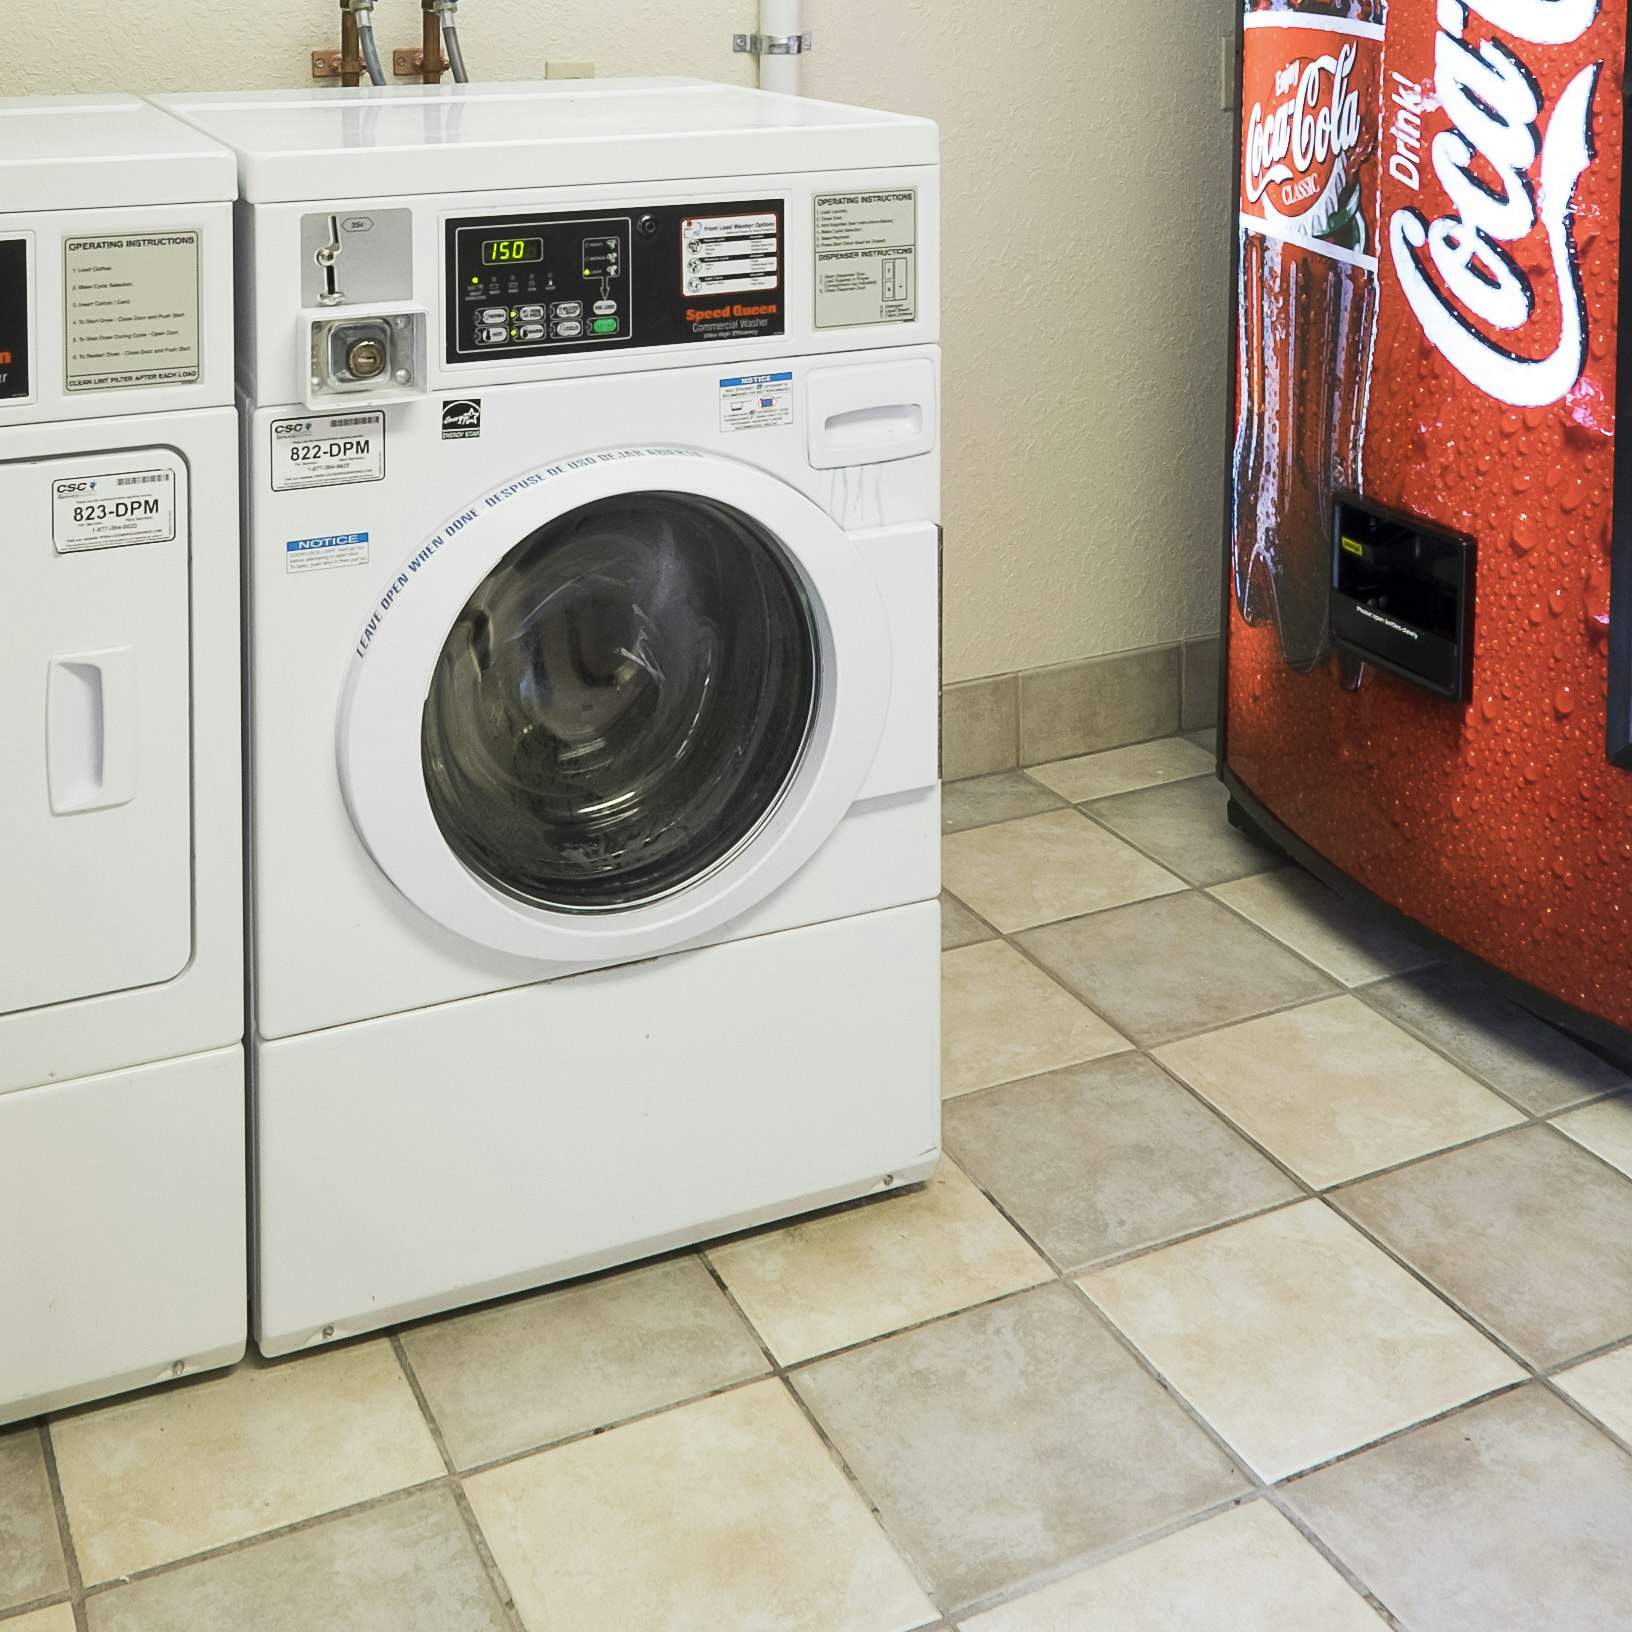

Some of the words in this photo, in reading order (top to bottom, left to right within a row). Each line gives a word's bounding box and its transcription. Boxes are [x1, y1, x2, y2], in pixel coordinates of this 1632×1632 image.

[1275, 60, 1299, 97] Enjoy
[1245, 40, 1361, 203] Coca-Cola
[1389, 71, 1422, 191] Drink!
[1281, 173, 1320, 206] CLASSIC
[817, 196, 859, 206] OPERATING
[861, 193, 912, 204] INSTRUCTIONS
[68, 240, 123, 251] OPERATING
[126, 236, 194, 248] INSTRUCTIONS
[492, 241, 525, 260] 150
[818, 251, 859, 261] DISPENSER
[861, 248, 912, 258] INSTRUCTIONS
[686, 304, 731, 322] Speed
[733, 304, 777, 317] Queen
[692, 320, 738, 333] Commercial
[740, 318, 769, 328] Washer
[110, 376, 133, 384] FILTER
[134, 374, 157, 382] AFTER
[178, 370, 197, 378] LOAD
[275, 423, 303, 433] CSC
[290, 440, 369, 461] 822-DPM
[57, 482, 87, 493] CSC
[73, 499, 159, 522] 823-DPM
[298, 534, 359, 549] NOTICE
[356, 610, 383, 659] LEAVE
[380, 573, 409, 611] OPEN
[408, 535, 445, 573] WHEN
[445, 508, 479, 537] DONE
[485, 472, 545, 508] DESPUSE
[546, 465, 565, 477] DE
[567, 456, 596, 469] USO
[597, 449, 646, 462] DEJAR
